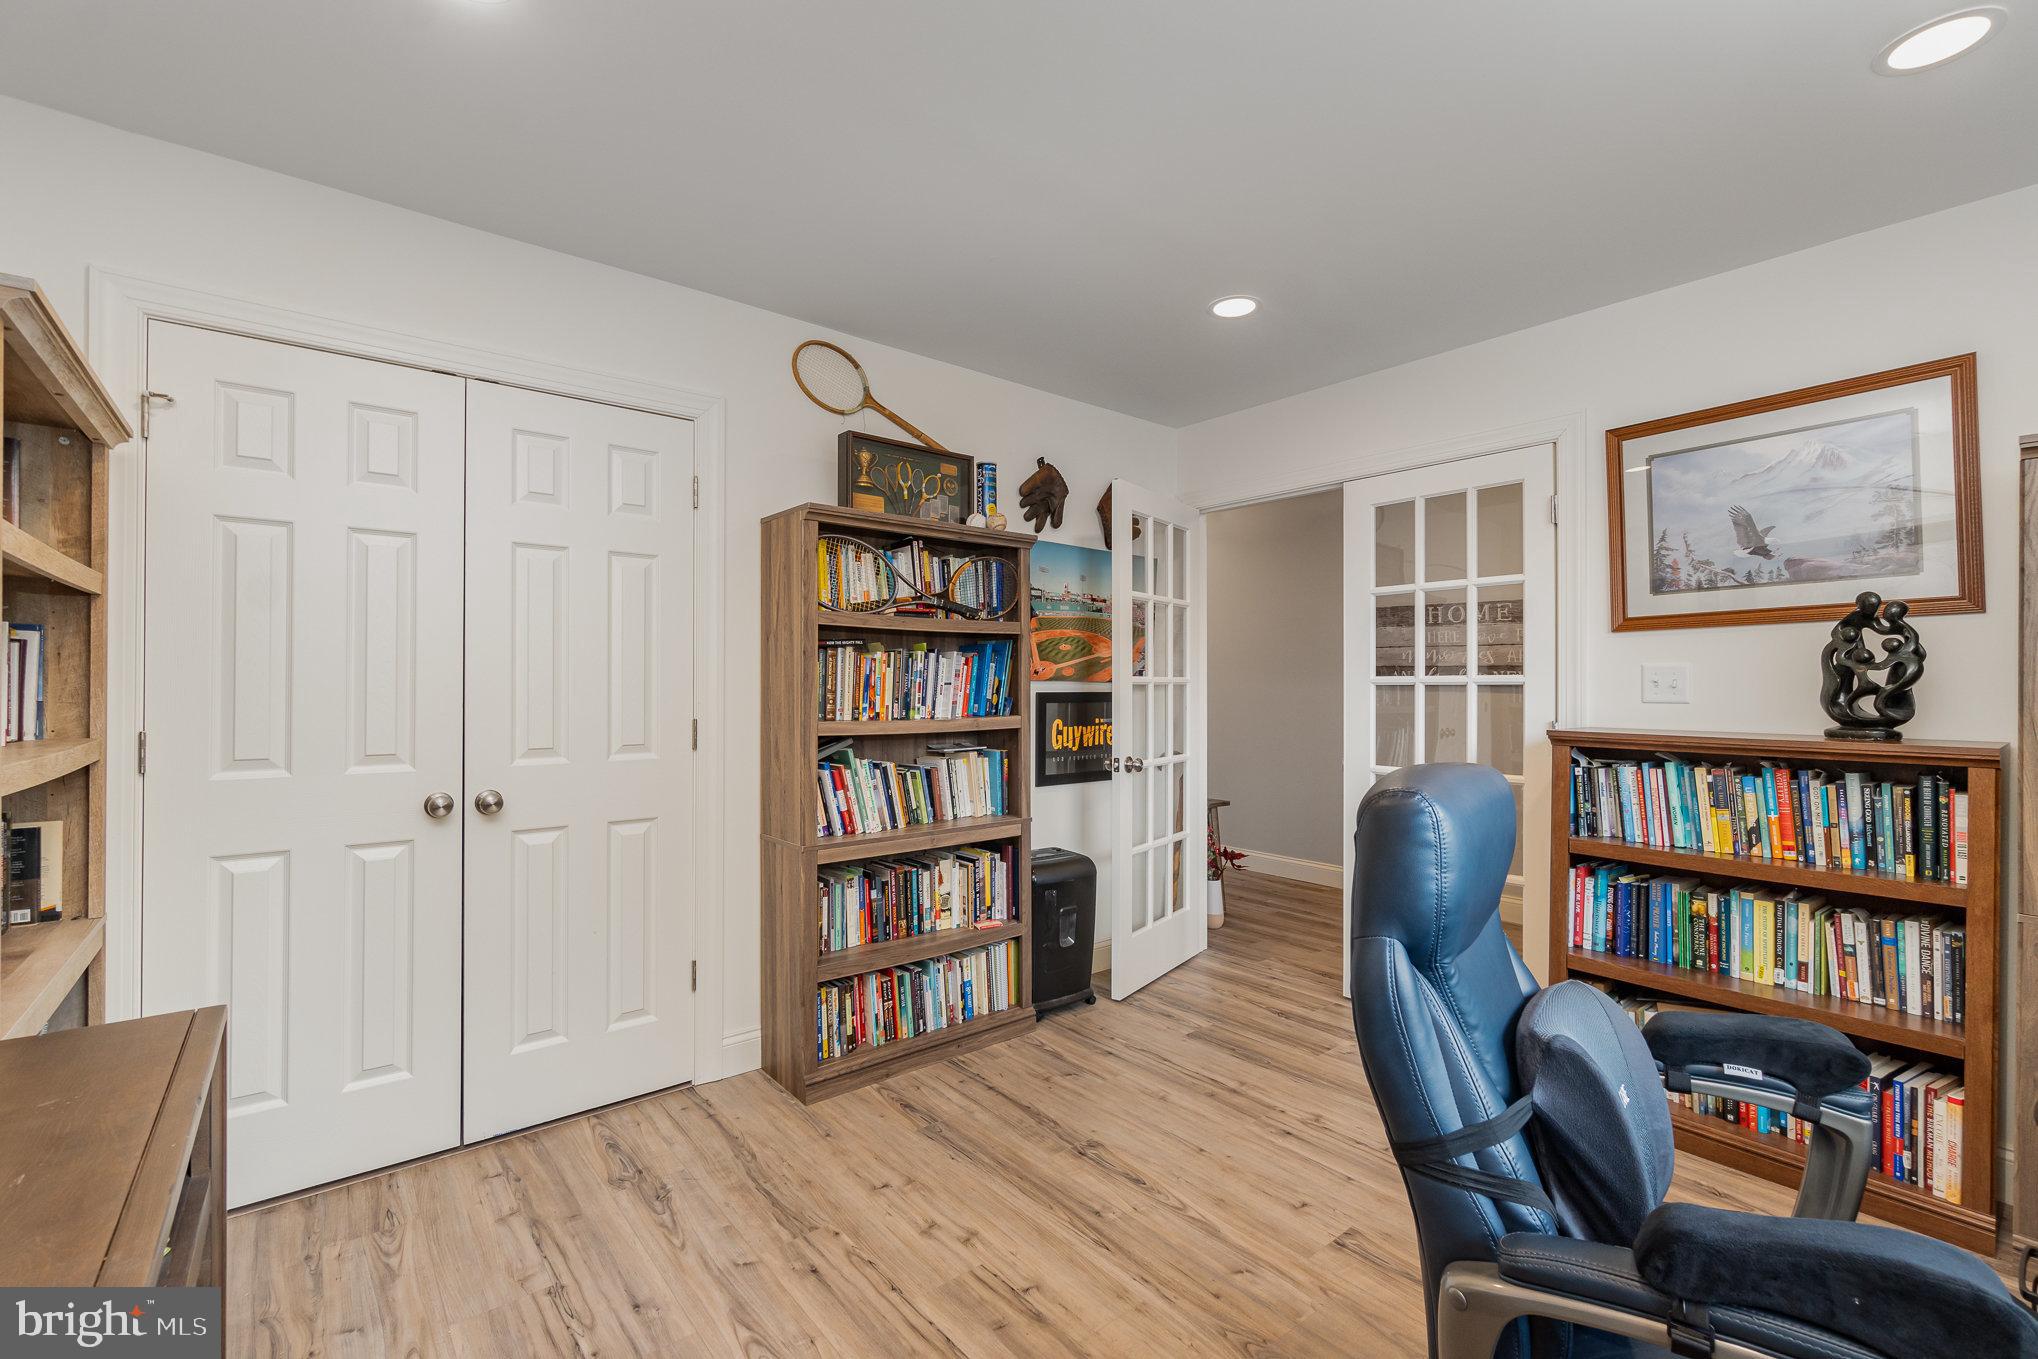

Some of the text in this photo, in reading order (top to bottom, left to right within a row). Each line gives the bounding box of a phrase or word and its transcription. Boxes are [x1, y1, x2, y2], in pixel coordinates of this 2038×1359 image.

[1427, 602, 1512, 624] HOME
[1776, 772, 1784, 805] AGILITY
[1920, 924, 1931, 974] DIVINE DANCE
[1726, 1064, 1759, 1075] DOKICAT
